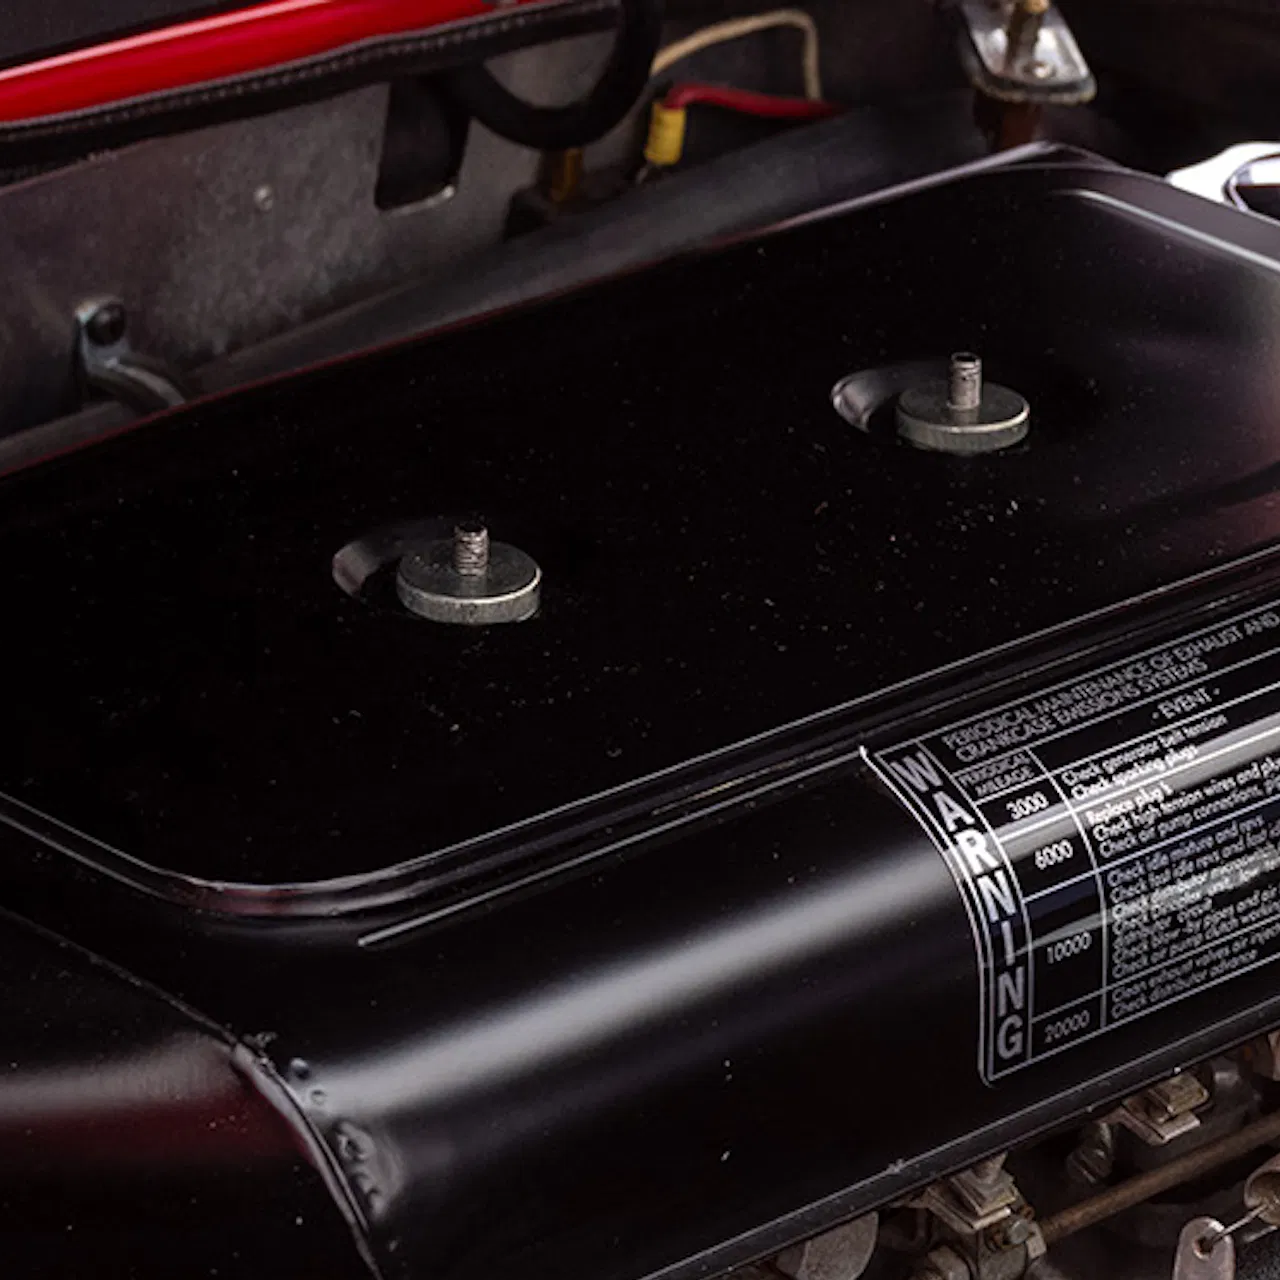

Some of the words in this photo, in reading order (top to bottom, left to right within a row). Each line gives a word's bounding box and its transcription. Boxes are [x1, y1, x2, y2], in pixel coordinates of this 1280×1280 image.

[941, 706, 1036, 749] PERIODICAL
[1034, 661, 1151, 714] MAINTENANCE
[1148, 651, 1174, 670] OF
[1172, 625, 1243, 661] EXHAUST
[1242, 611, 1280, 635] AND
[955, 714, 1056, 762] CRANKCASE
[1051, 683, 1140, 725] EMISSIONS
[1137, 657, 1207, 692] SYSTEMS
[1157, 687, 1212, 719] EVENT
[1060, 762, 1103, 786] Check
[1070, 775, 1112, 802] Check
[1005, 791, 1049, 819] 3000
[1084, 794, 1135, 828] Replace
[1092, 814, 1132, 841] Check
[1129, 803, 1162, 829] high
[1157, 789, 1203, 814] tension
[1235, 761, 1261, 785] and
[1034, 839, 1073, 869] 6000
[1098, 831, 1138, 858] Check
[1106, 859, 1145, 887] Check
[1214, 819, 1239, 844] and
[1109, 877, 1147, 903] Check
[1219, 834, 1245, 858] and
[891, 752, 1024, 1058] WARNING
[1236, 889, 1260, 913] and
[1046, 928, 1092, 963] 10000
[1110, 992, 1146, 1019] Check
[1044, 1009, 1090, 1043] 20000
